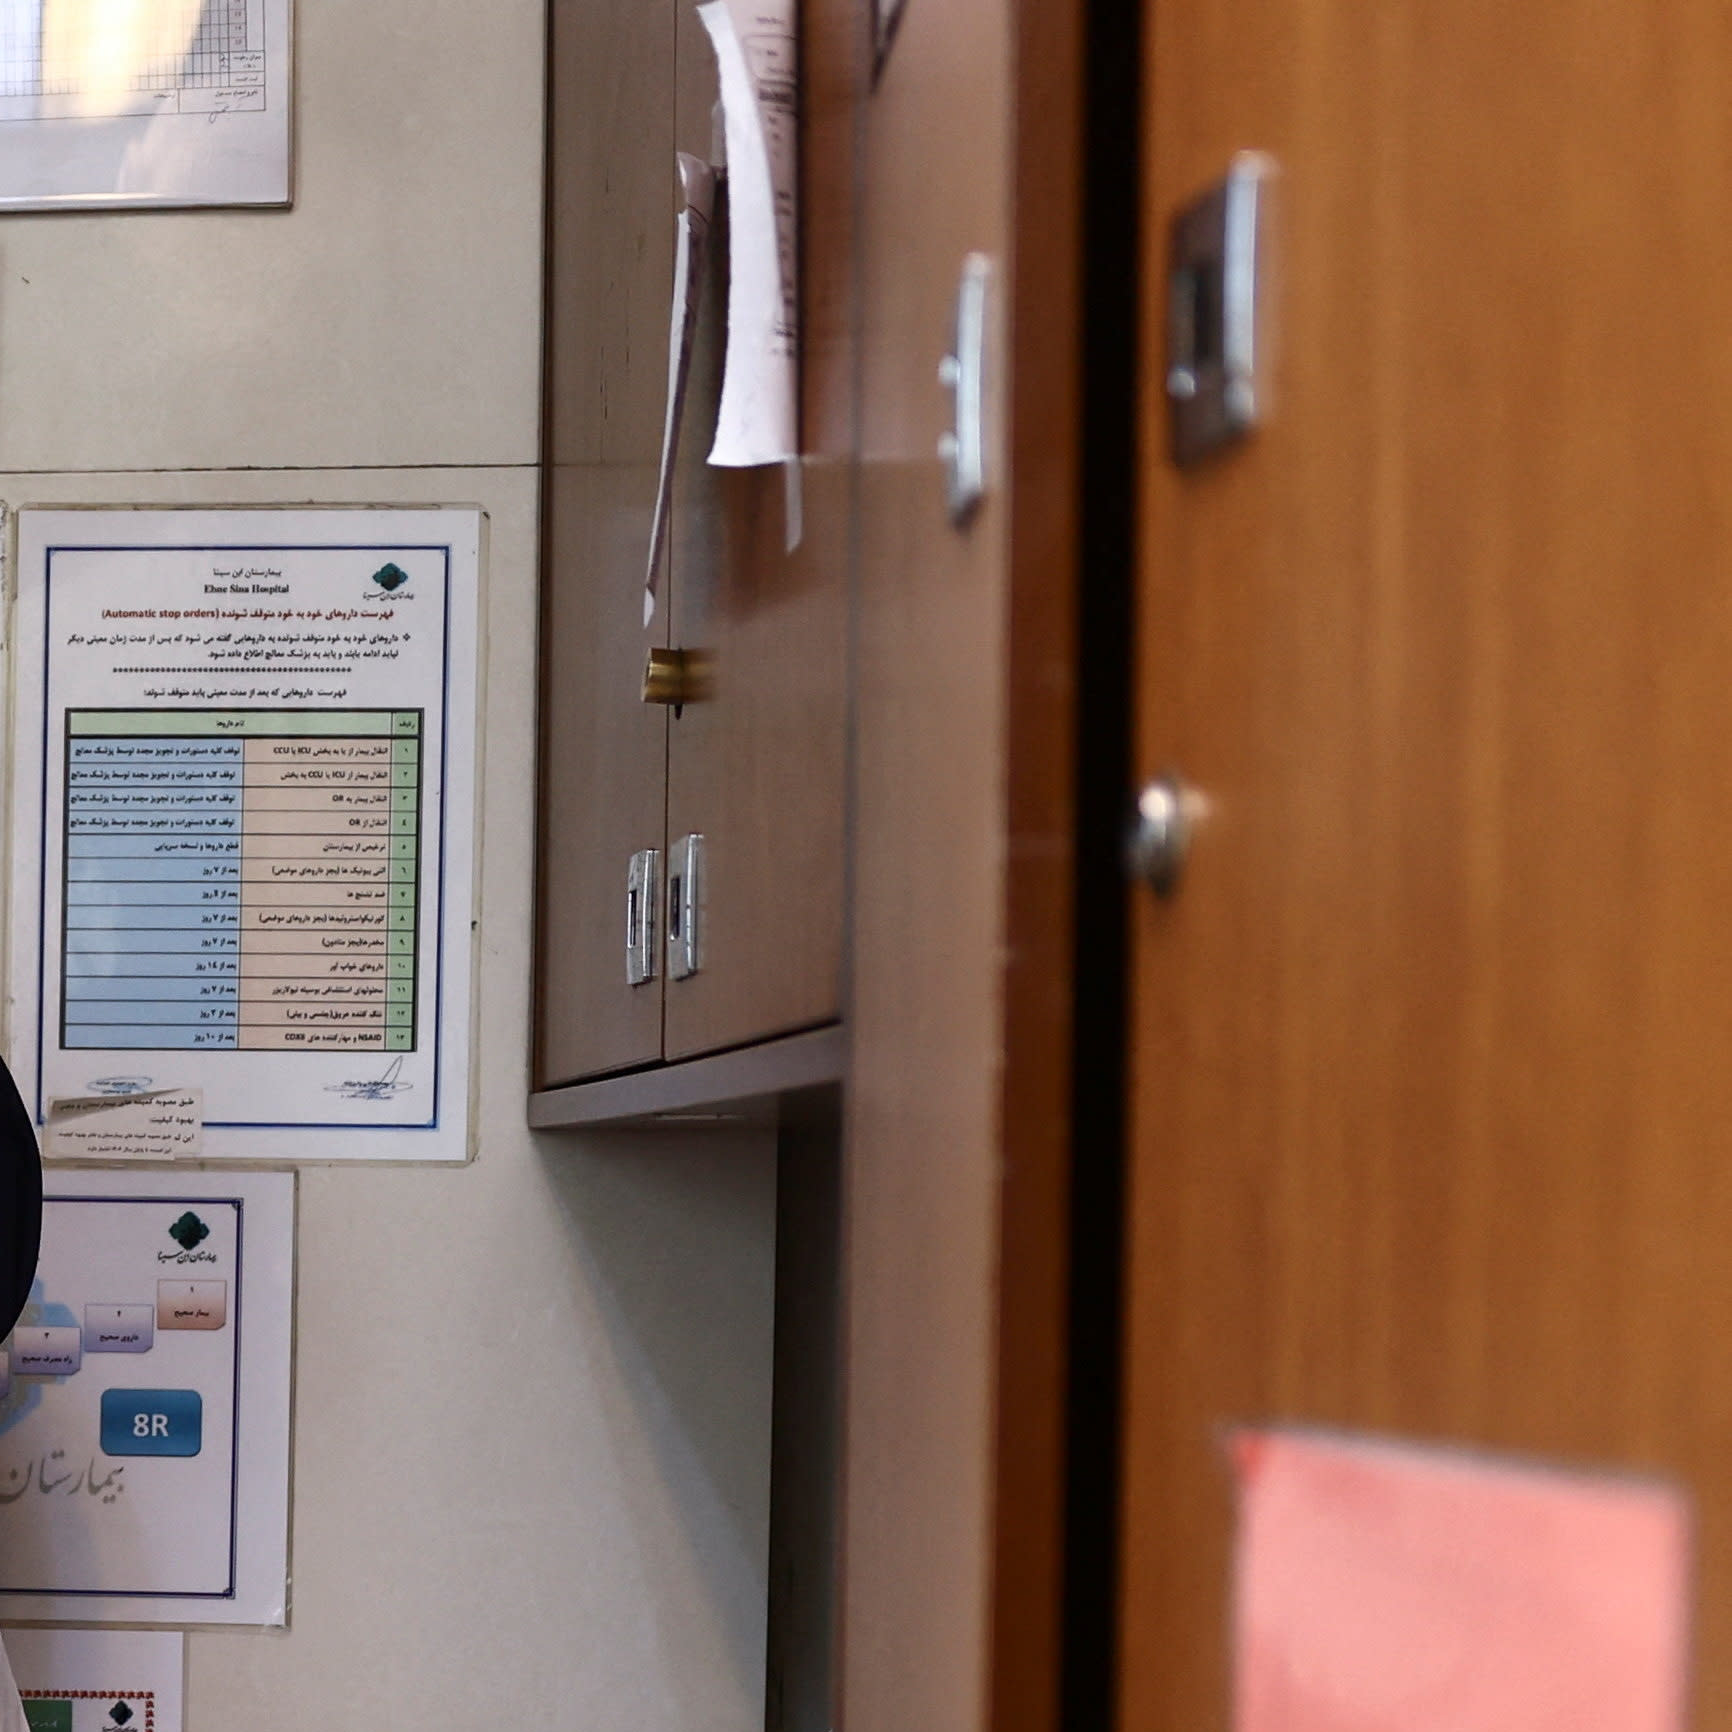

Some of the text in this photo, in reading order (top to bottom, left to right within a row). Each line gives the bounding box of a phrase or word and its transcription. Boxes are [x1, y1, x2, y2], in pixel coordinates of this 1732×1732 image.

[212, 567, 283, 579] بیمارستان ابن سینا
[230, 584, 249, 594] Sina
[252, 584, 289, 596] Hospital
[158, 609, 182, 621] stop
[221, 608, 249, 622] شونده
[249, 608, 276, 621] متوقف
[277, 608, 294, 622] خود
[295, 611, 305, 620] به
[306, 609, 323, 621] خود
[324, 608, 359, 621] داروهای
[359, 608, 395, 621] فهرست
[131, 1412, 170, 1439] 8R
